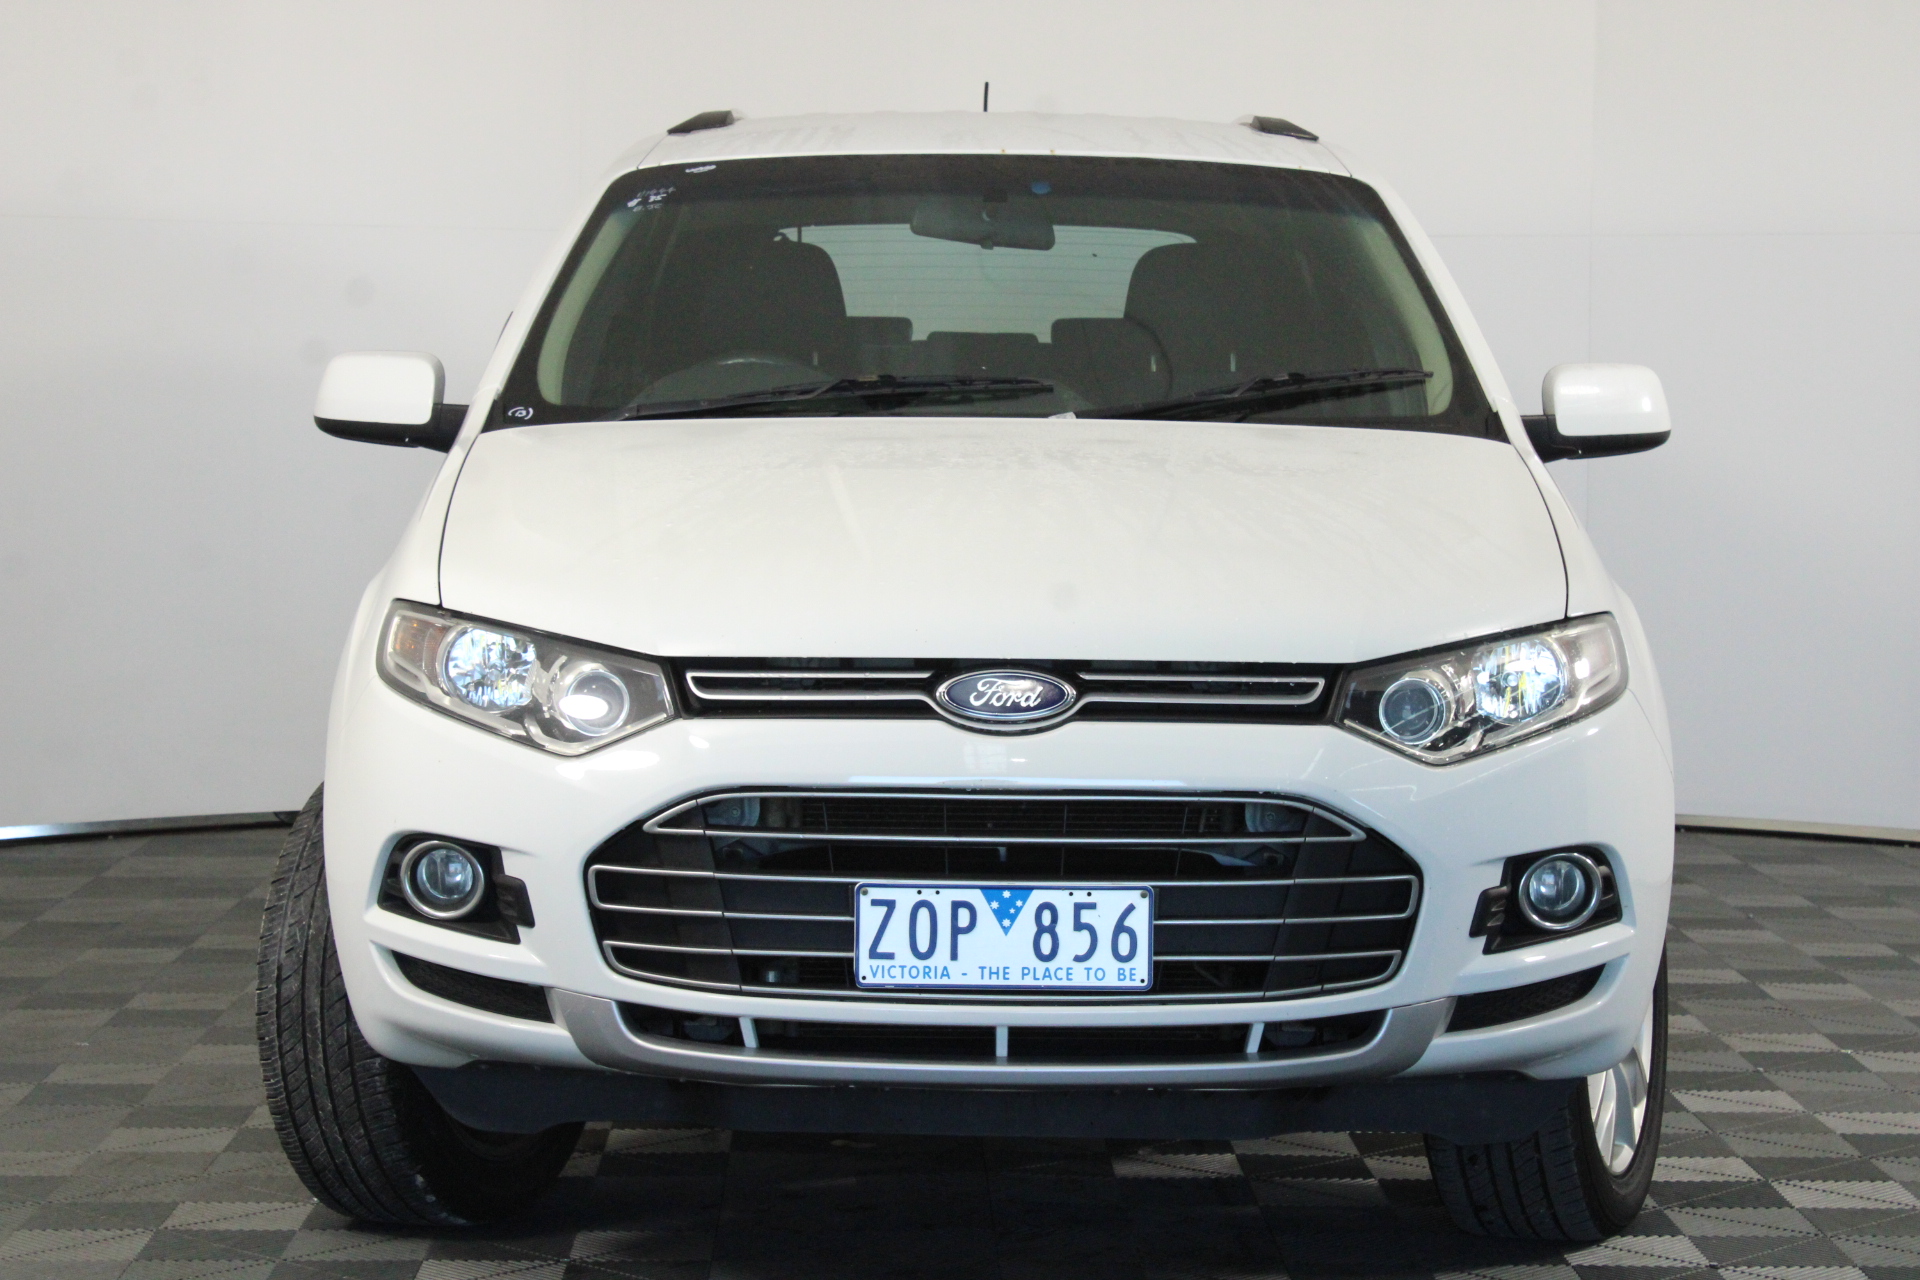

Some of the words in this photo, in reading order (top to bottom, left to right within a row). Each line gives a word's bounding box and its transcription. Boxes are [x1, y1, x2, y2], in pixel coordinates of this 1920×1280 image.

[969, 677, 1043, 707] Ford
[1032, 901, 1138, 963] 856
[869, 965, 951, 980] VICTORIA
[978, 966, 1010, 981] THE
[1021, 966, 1074, 981] PLACE
[1084, 967, 1106, 981] TO
[1117, 967, 1137, 981] BE
